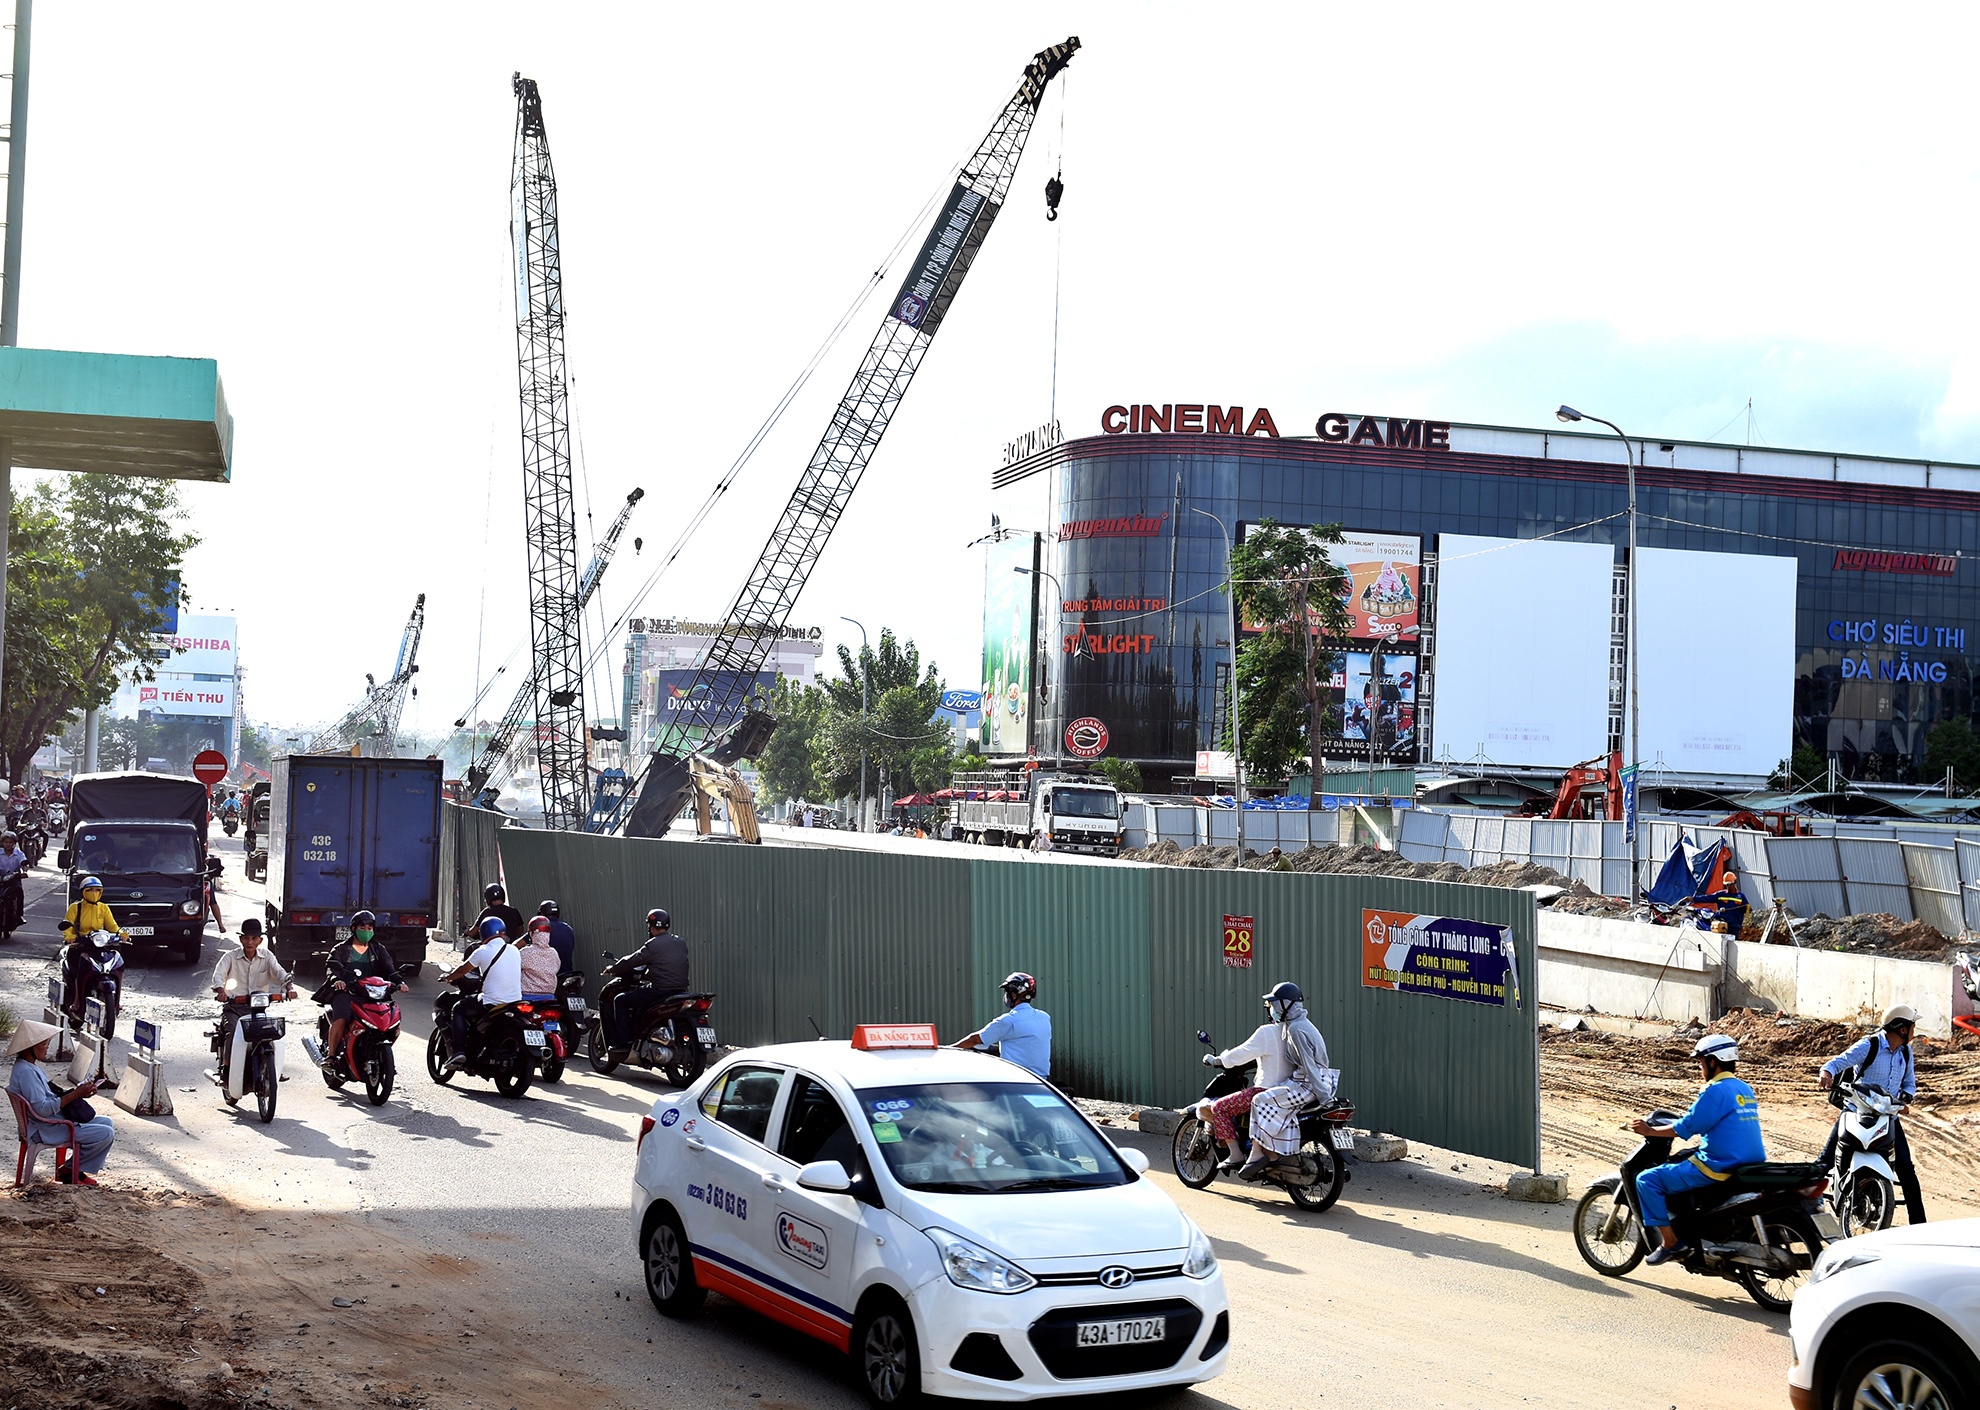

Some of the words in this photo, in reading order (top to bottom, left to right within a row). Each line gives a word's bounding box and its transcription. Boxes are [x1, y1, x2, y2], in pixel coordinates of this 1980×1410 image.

[957, 189, 982, 215] TRUNG
[921, 269, 939, 283] TY
[926, 261, 943, 275] CP
[911, 279, 935, 301] CÔNG
[1102, 404, 1280, 438] CINEMA
[1315, 412, 1450, 451] GAME
[1380, 548, 1413, 556] 19001744
[1062, 599, 1088, 612] TRUNG
[1090, 596, 1112, 611] TÂM
[1114, 595, 1140, 611] GIẢI
[1143, 596, 1166, 611] TRÍ
[1368, 615, 1402, 633] Scoo
[1062, 626, 1155, 659] STARLIGHT
[1827, 619, 1876, 648] CHỢ
[1882, 619, 1928, 647] SIÊU
[1934, 627, 1965, 653] THỊ
[1841, 652, 1873, 680] ĐÀ
[1879, 651, 1947, 683] NẴNG
[1400, 671, 1413, 688] 2
[162, 688, 193, 702] TIẾN
[197, 693, 224, 704] THU
[668, 696, 705, 711] Dulux
[945, 691, 980, 709] Ford
[1068, 718, 1106, 736] HIGHLANDS
[1072, 745, 1102, 756] COFFEE
[1366, 742, 1383, 750] 217
[1066, 822, 1107, 830] HYUNDAI
[311, 835, 332, 846] 43C
[303, 850, 337, 861] 032.18
[1224, 929, 1251, 952] 28
[1388, 920, 1407, 945] TỔNG
[1409, 926, 1430, 948] CÔNG
[1432, 931, 1440, 949] TY
[1442, 931, 1467, 951] THĂNG
[1470, 936, 1490, 955] LONG
[1416, 953, 1439, 969] CÔNG
[1441, 957, 1469, 973] TRÌNH:
[1369, 965, 1382, 979] NÚT
[1383, 969, 1398, 983] GIAO
[1400, 970, 1414, 987] ĐIỆN
[1416, 973, 1431, 987] BIÊN
[1433, 974, 1446, 990] PHỦ
[1480, 982, 1491, 996] TRI
[869, 1031, 882, 1041] ĐÀ
[884, 1030, 909, 1041] NẴNG
[910, 1033, 931, 1041] TAXI
[876, 1100, 910, 1110] 066
[663, 1111, 678, 1124] 066
[706, 1183, 713, 1204] 3
[714, 1186, 724, 1209] 63
[725, 1191, 735, 1214] 63
[737, 1197, 747, 1220] 63
[813, 1242, 824, 1255] TAXI
